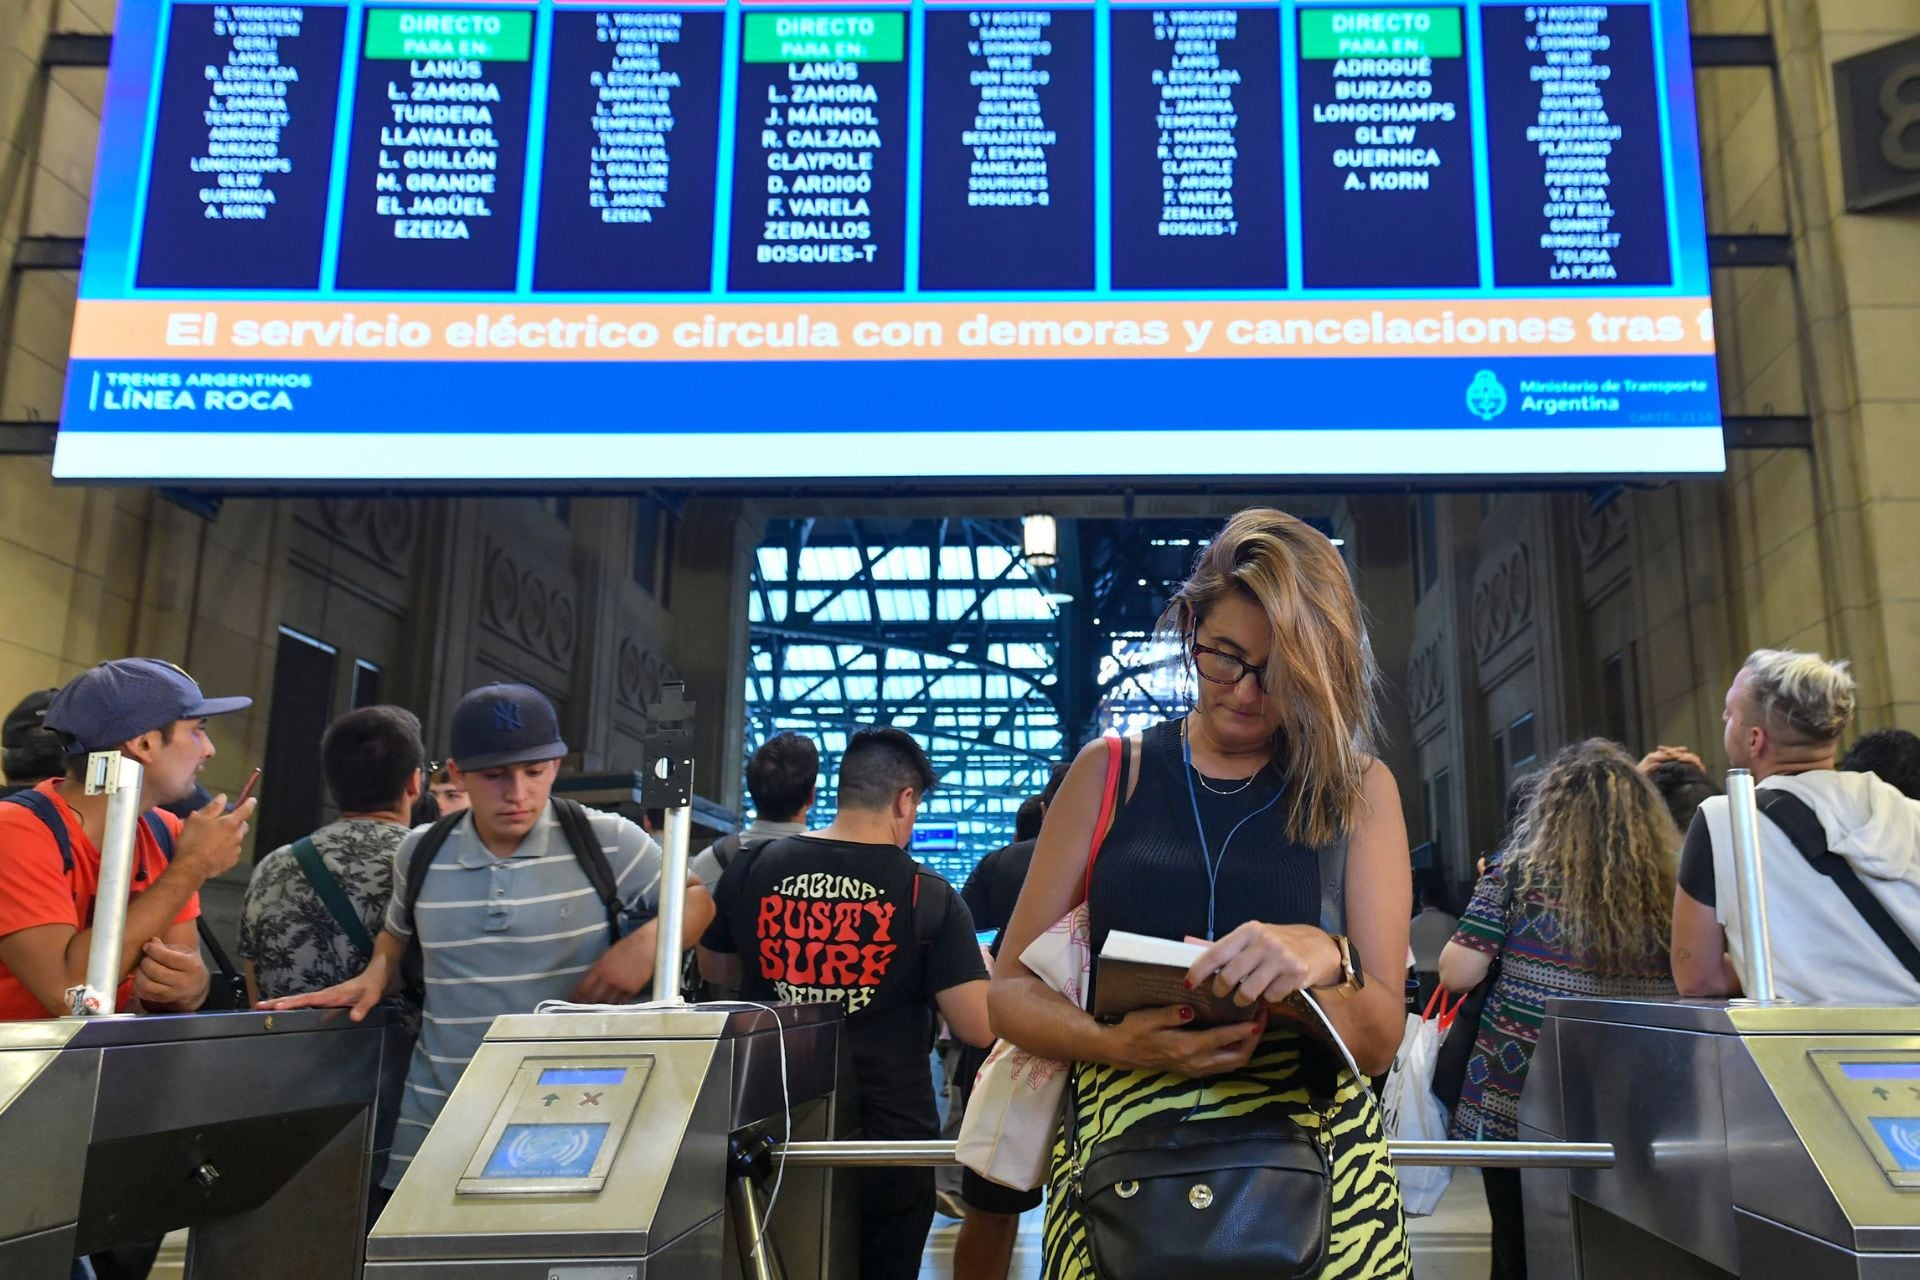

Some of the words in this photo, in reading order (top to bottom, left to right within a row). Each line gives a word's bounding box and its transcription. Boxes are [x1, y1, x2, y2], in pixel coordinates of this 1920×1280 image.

[400, 14, 500, 34] DIRECTO
[777, 17, 874, 37] DIRECTO
[1332, 13, 1430, 33] DIRECTO
[404, 38, 456, 56] PARA
[781, 41, 832, 58] PARA
[1339, 36, 1390, 54] PARA
[388, 81, 407, 100] L.
[411, 82, 499, 101] ZAMORA
[768, 85, 786, 103] L.
[791, 84, 877, 103] ZAMORA
[1335, 80, 1432, 100] BURZACO
[392, 104, 492, 124] TURDERA
[765, 107, 783, 125] J.
[788, 106, 878, 125] MÁRMOL
[1313, 102, 1455, 122] LONGCHAMPS
[380, 127, 497, 147] LLAVALLOL
[762, 129, 782, 148] R.
[786, 129, 881, 148] CALZADA
[1355, 125, 1416, 145] GLEW
[379, 150, 399, 169] L.
[403, 150, 496, 170] GUILLÓN
[767, 152, 872, 171] CLAYPOLE
[1333, 148, 1440, 168] GUERNICA
[376, 173, 401, 192] M.
[406, 173, 494, 193] GRANDE
[767, 175, 788, 193] D.
[792, 174, 871, 193] ARDIGÓ
[1344, 172, 1366, 190] A.
[1370, 171, 1429, 190] KORN
[767, 198, 784, 216] F.
[788, 198, 869, 216] VARELA
[394, 219, 468, 239] EZEIZA
[763, 221, 870, 240] ZEBALLOS
[757, 244, 877, 263] BOSQUES-T
[166, 312, 218, 346] El
[231, 313, 432, 348] servicio
[446, 314, 660, 349] eléctrico
[673, 314, 841, 348] circula
[853, 322, 943, 347] con
[958, 313, 1170, 346] demoras
[1184, 319, 1213, 353] y
[1227, 311, 1576, 345] cancelaciones
[1588, 311, 1685, 343] tras
[106, 373, 182, 388] TRENES
[185, 373, 312, 388] ARGENTINOS
[1520, 379, 1599, 393] Ministerio
[1601, 379, 1621, 393] de
[1624, 379, 1708, 395] Transporte
[103, 384, 195, 411] LÍNEA
[205, 391, 293, 411] ROCA
[1521, 394, 1620, 415] Argentina
[780, 873, 877, 900] LAGUNA
[757, 894, 897, 942] RUSTY
[758, 938, 897, 986] SURF
